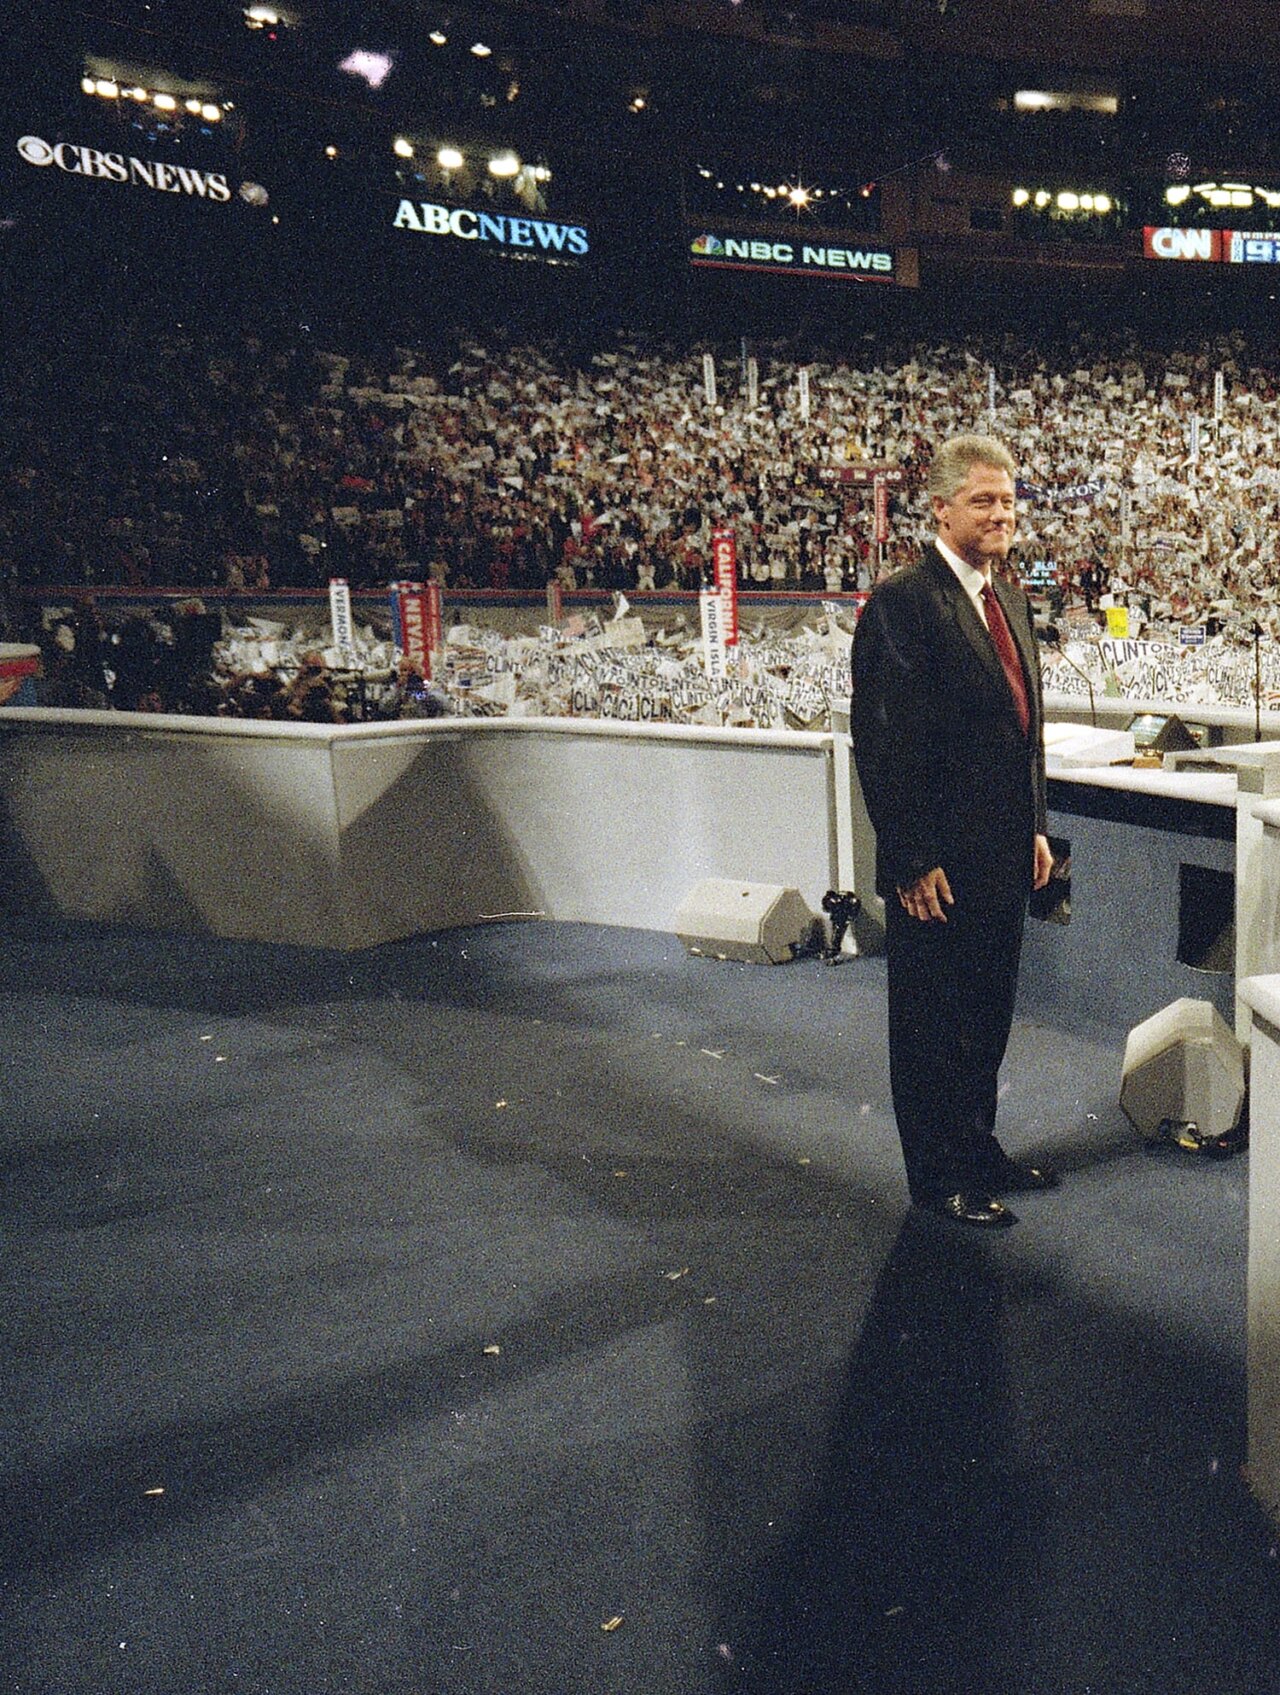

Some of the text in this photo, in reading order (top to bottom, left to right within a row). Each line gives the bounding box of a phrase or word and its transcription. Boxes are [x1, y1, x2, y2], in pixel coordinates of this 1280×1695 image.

[53, 143, 231, 201] CBS NEWS
[393, 200, 589, 254] ABC NEWS
[1152, 227, 1212, 259] CNN
[724, 239, 892, 270] NBC NEWS
[335, 590, 350, 646] VERMON
[405, 599, 424, 651] NEVA
[706, 600, 721, 676] VIRGIN ISLA
[1102, 641, 1174, 666] CLINTON
[641, 697, 672, 720] CLIN
[673, 692, 713, 709] CLINTO
